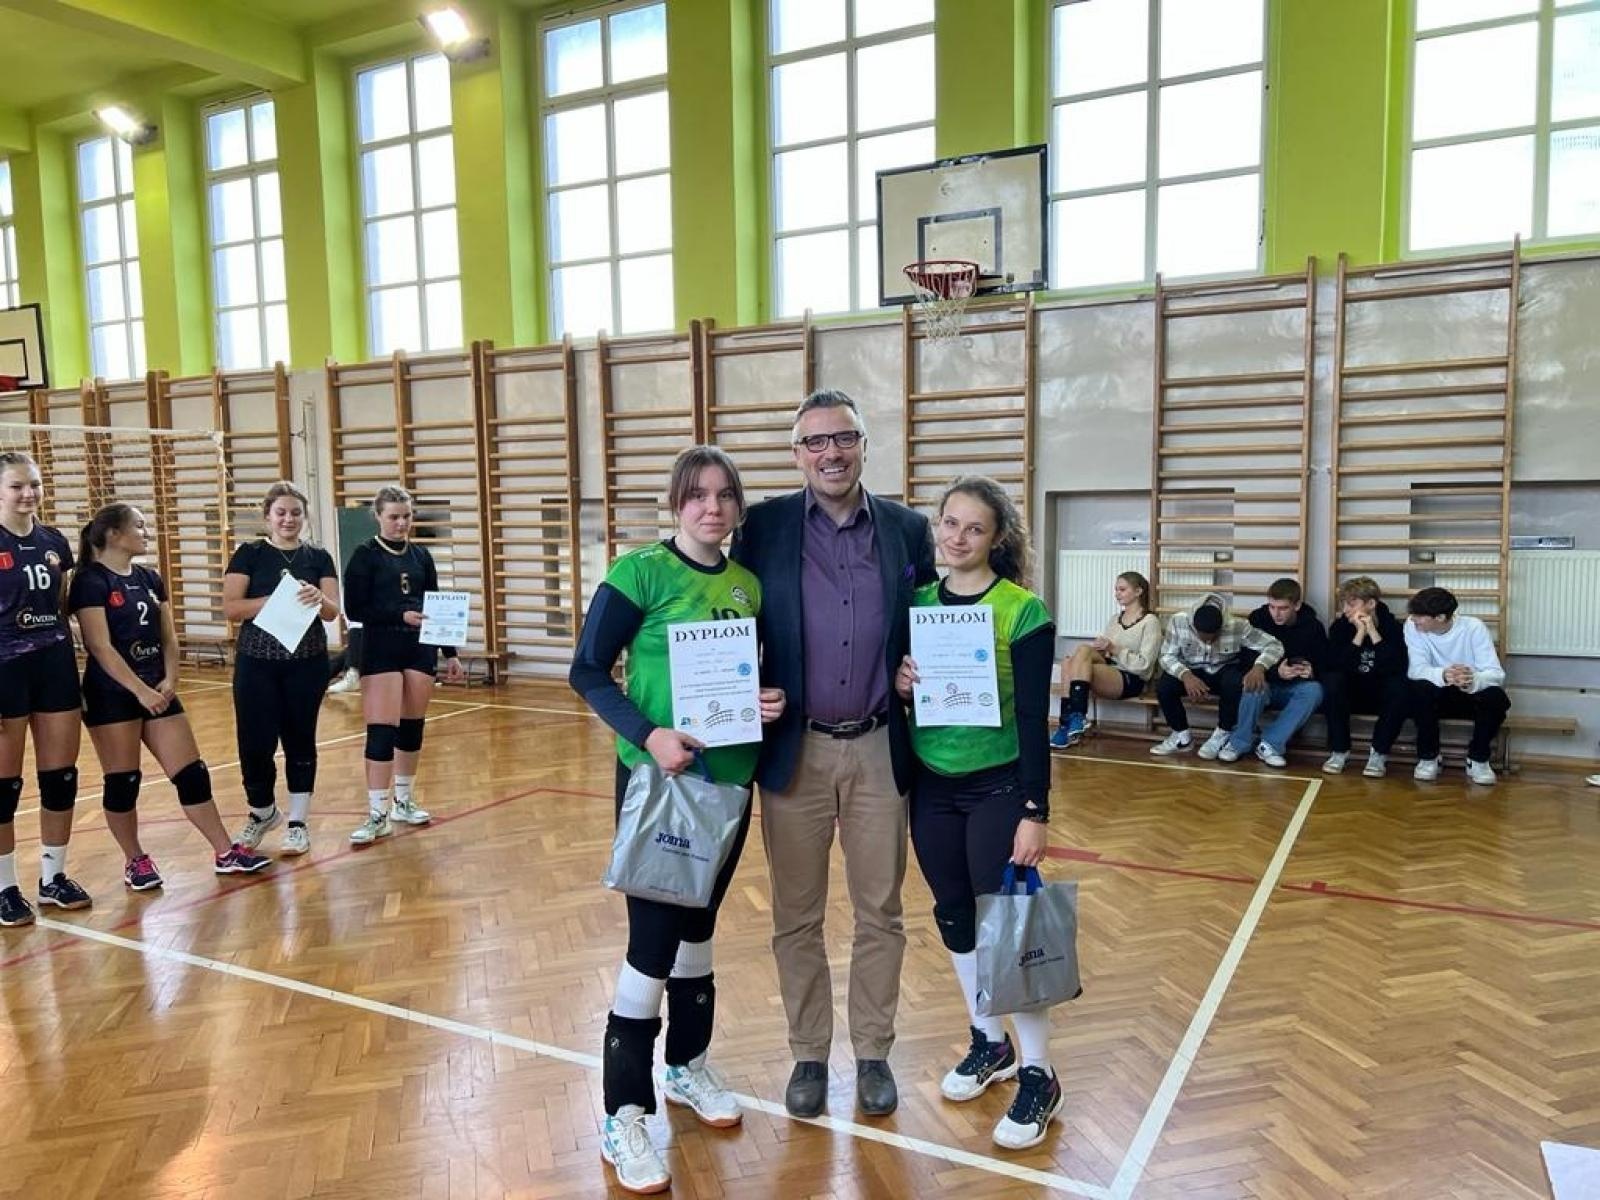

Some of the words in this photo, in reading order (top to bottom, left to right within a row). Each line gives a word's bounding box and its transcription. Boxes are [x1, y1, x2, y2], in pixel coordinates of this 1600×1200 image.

[22, 563, 51, 590] 16
[136, 600, 149, 626] 2
[916, 612, 987, 624] DYPLOM
[674, 625, 751, 643] DYPLOM
